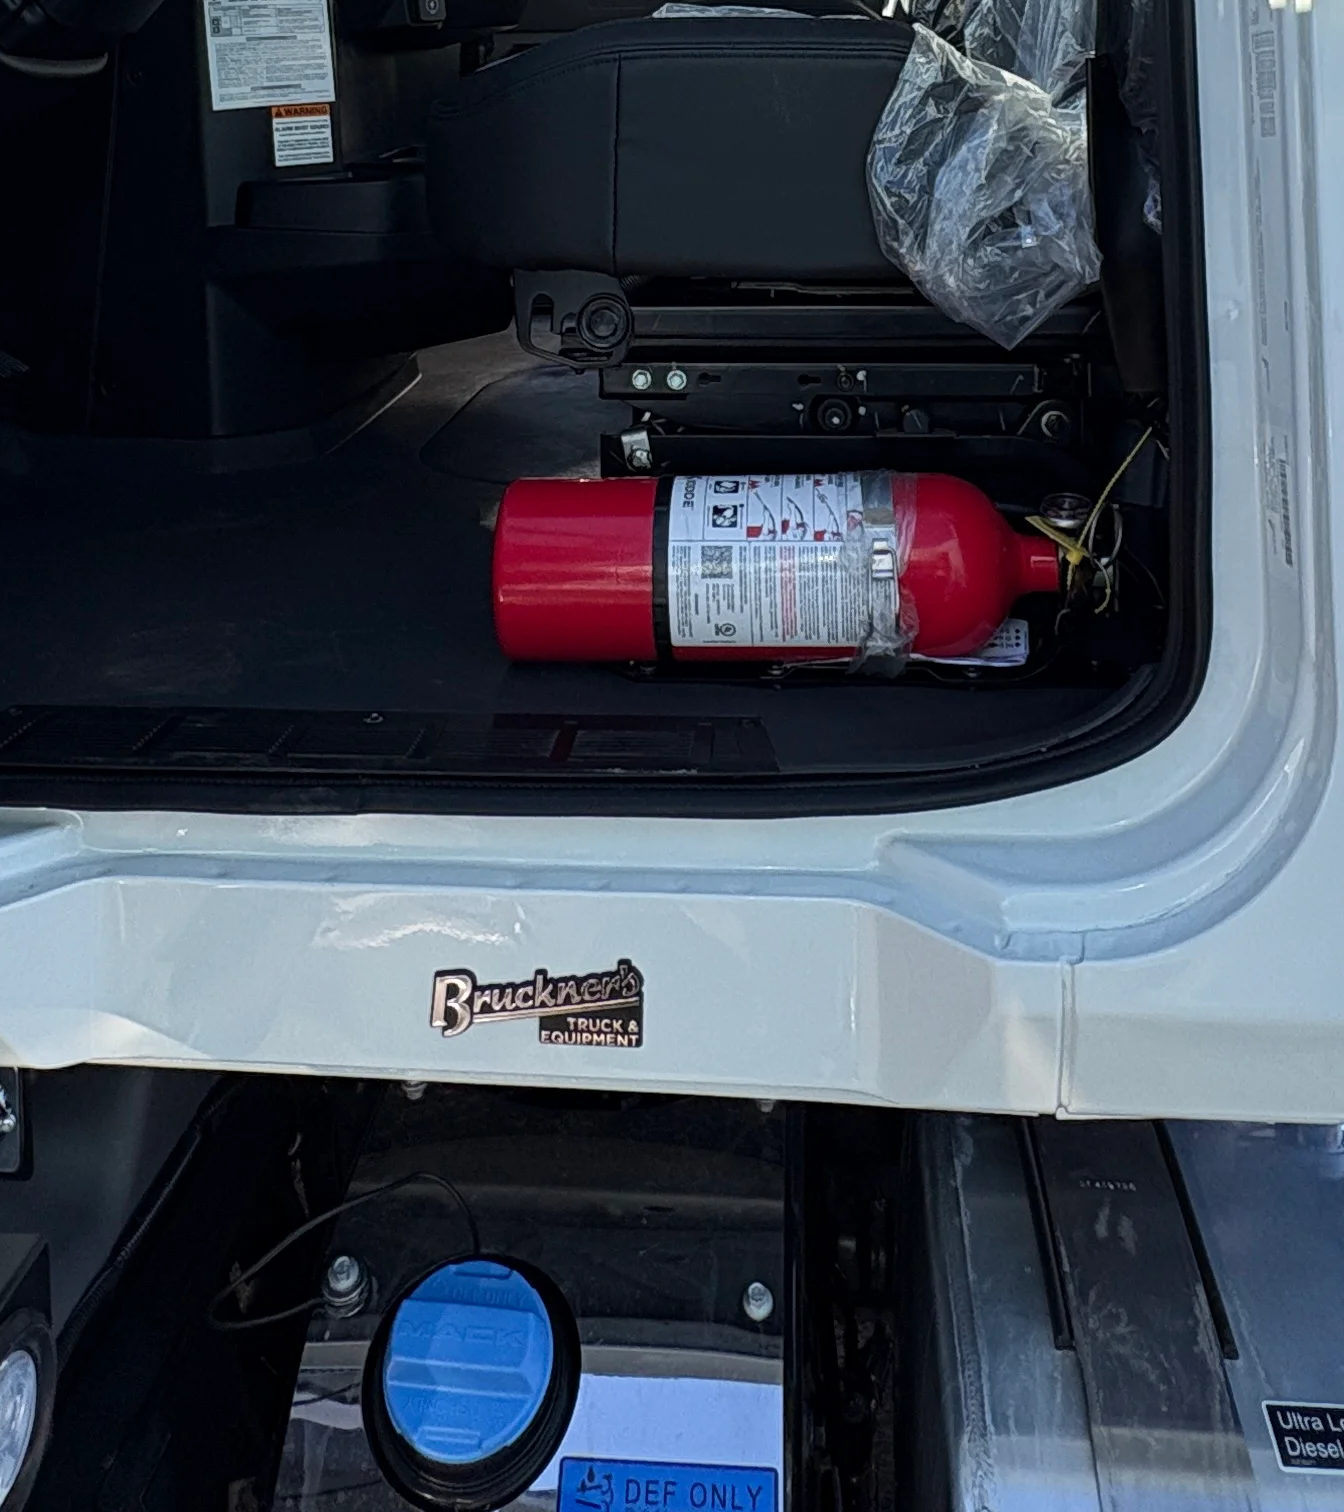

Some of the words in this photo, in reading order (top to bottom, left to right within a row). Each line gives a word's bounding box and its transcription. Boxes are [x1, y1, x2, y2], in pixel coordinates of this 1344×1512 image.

[284, 106, 328, 116] WARNING
[430, 958, 644, 1038] Bruckner's
[567, 1016, 623, 1032] TRUCK
[627, 1019, 639, 1032] &
[541, 1031, 640, 1047] EQUIPMENT
[398, 1320, 525, 1348] MACK
[1276, 1411, 1324, 1431] Ultra
[1284, 1437, 1344, 1459] Diesel
[625, 1479, 677, 1507] DEF
[690, 1483, 763, 1510] ONLY
